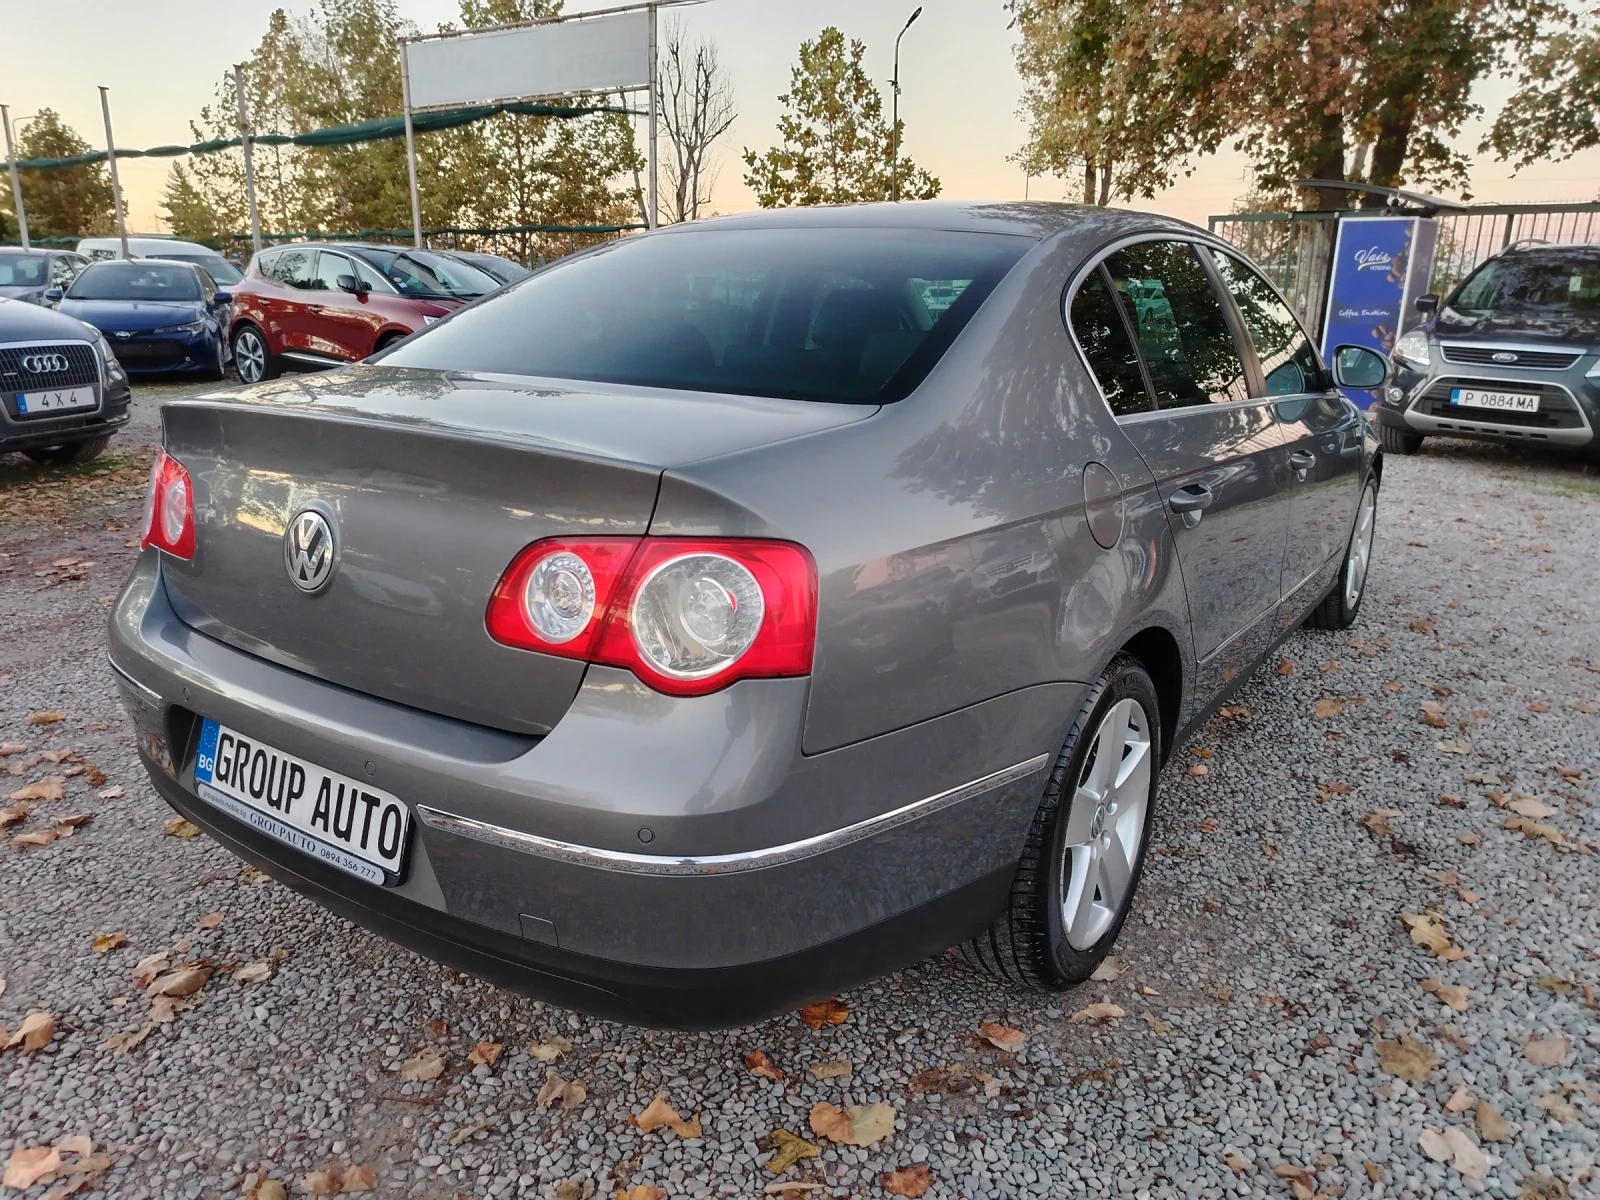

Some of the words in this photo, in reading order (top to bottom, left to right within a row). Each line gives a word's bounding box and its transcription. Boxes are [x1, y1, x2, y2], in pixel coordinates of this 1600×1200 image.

[1354, 246, 1391, 263] Vais
[1339, 309, 1359, 318] Coffee
[42, 394, 49, 407] 4
[55, 392, 64, 406] X
[70, 391, 77, 404] 4
[1464, 392, 1474, 404] P
[1481, 394, 1514, 408] 0884
[1516, 397, 1534, 410] MA
[198, 754, 213, 772] BG
[215, 732, 306, 815] GROUP
[311, 775, 402, 860] AUTO
[203, 790, 247, 818] groupauto.mobile.bg
[250, 812, 315, 854] GROUPAUTO
[320, 848, 341, 864] 0894
[342, 858, 358, 872] 356
[361, 866, 376, 879] 777
